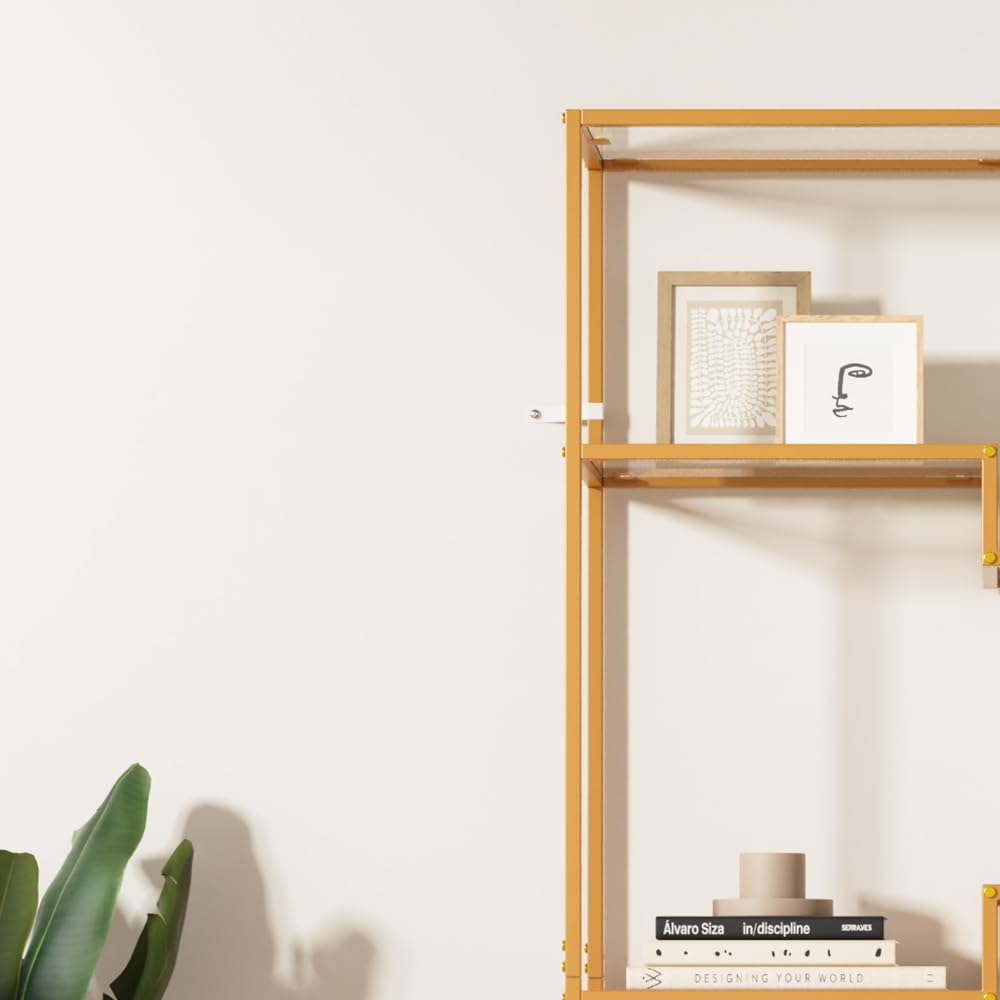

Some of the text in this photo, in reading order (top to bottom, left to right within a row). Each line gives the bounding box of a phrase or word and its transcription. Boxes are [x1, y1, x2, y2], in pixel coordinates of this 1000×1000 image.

[663, 919, 811, 937] Álvaro Siza in/discipline
[694, 973, 864, 983] DESIGNING YOUR WORLD
